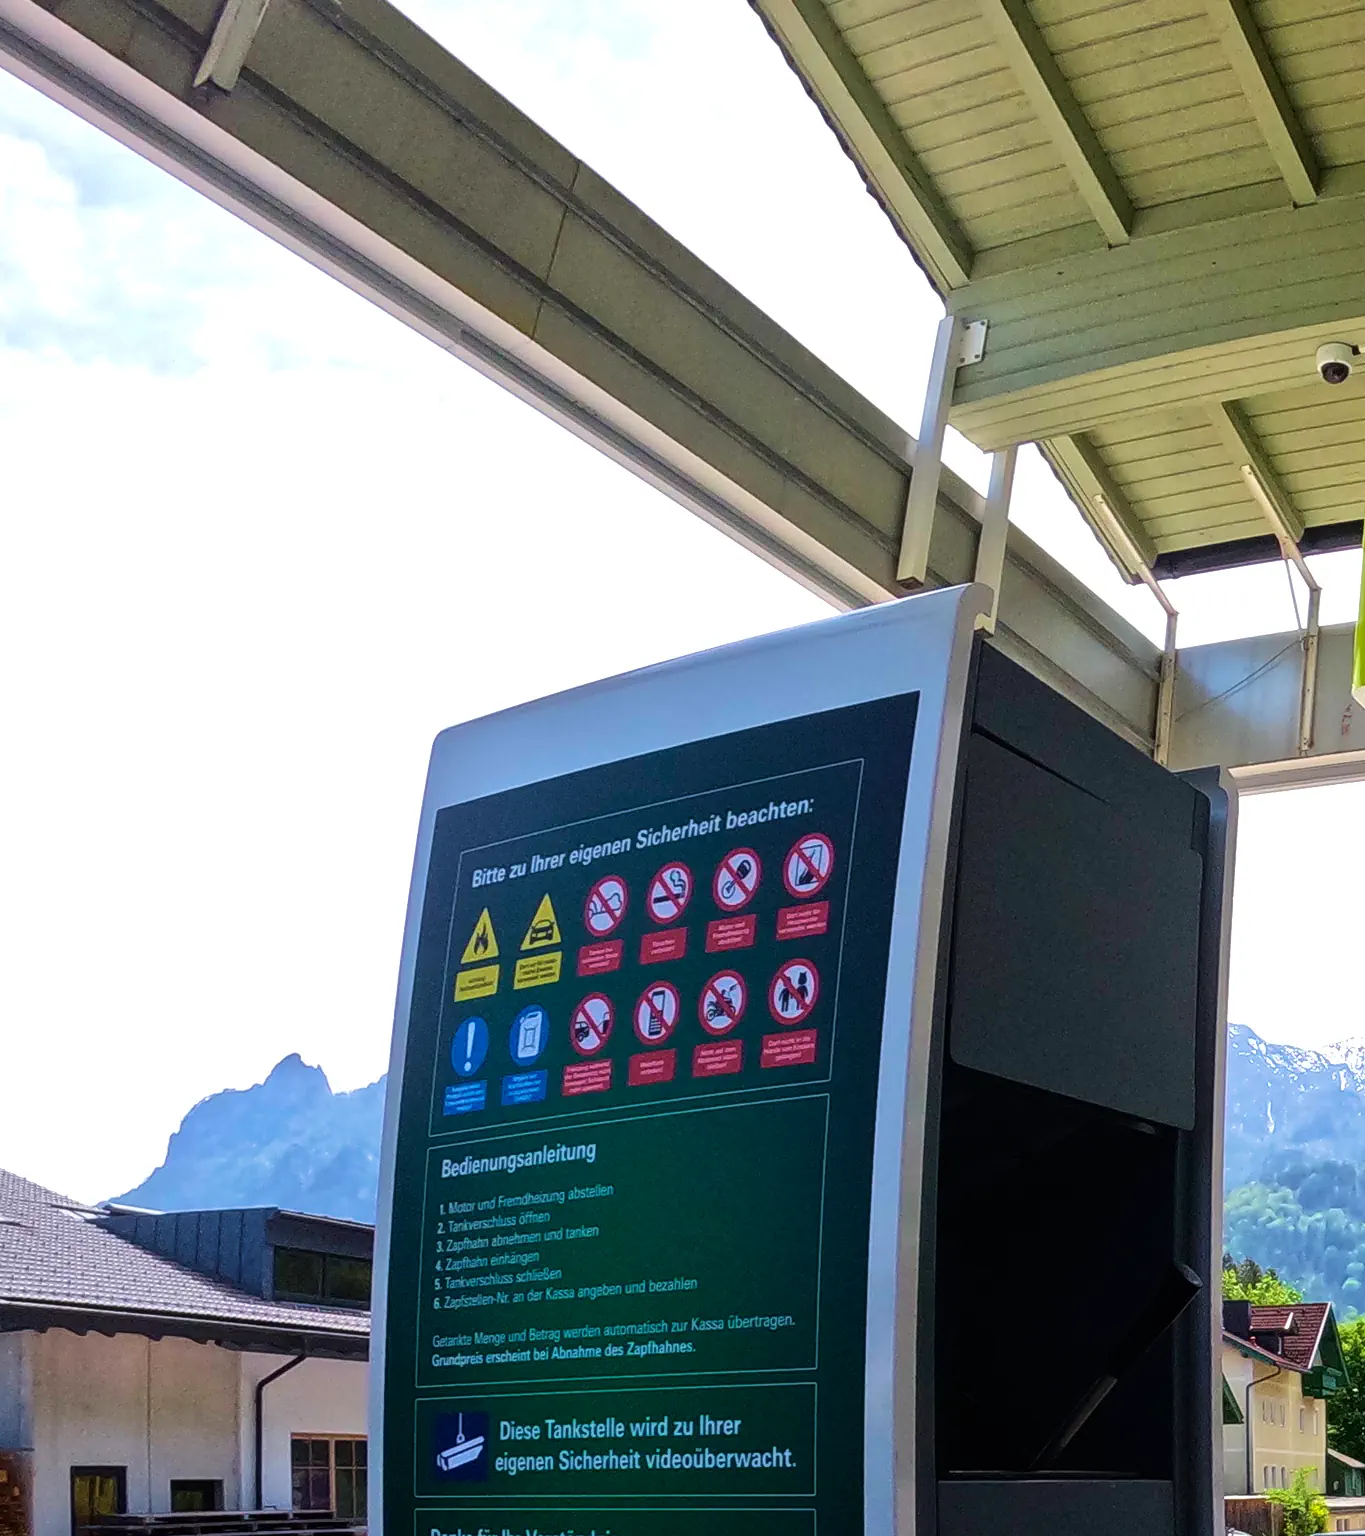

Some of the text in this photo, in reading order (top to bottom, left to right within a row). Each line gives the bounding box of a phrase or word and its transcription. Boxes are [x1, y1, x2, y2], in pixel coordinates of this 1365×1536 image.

[472, 798, 813, 888] Bitte zu Ihrer eigenen Sicherheit beachten:
[441, 1144, 596, 1178] Bedienungsanleitung
[448, 1201, 475, 1214] Motor
[478, 1197, 496, 1210] und
[497, 1190, 565, 1208] Fremdheizung
[567, 1184, 614, 1200] abstellen
[437, 1211, 550, 1234] 2. Tankverschluss öffnen
[436, 1240, 444, 1253] 3.
[491, 1231, 541, 1246] abnehmen
[544, 1228, 563, 1241] und
[565, 1225, 599, 1239] tanken
[435, 1260, 443, 1271] 4.
[490, 1251, 540, 1266] einhängen
[433, 1298, 442, 1310] 6.
[512, 1294, 524, 1303] an
[527, 1289, 544, 1302] der
[546, 1287, 575, 1301] Kassa
[577, 1283, 622, 1300] angeben
[625, 1281, 645, 1294] und
[648, 1277, 698, 1292] bezahlen
[434, 1268, 562, 1290] 5. Tankverschluss schließen
[432, 1314, 796, 1348] Getankte Menge und Betrag werden automatisch zur Kassa übertragen.
[432, 1340, 697, 1367] Grundpreis erscheint bei Abnahme des Zapfhahnes.
[500, 1414, 742, 1441] Diese Tankstelle wird zu Ihrer
[496, 1446, 798, 1477] eigenen Sicherheit videoüberwacht.
